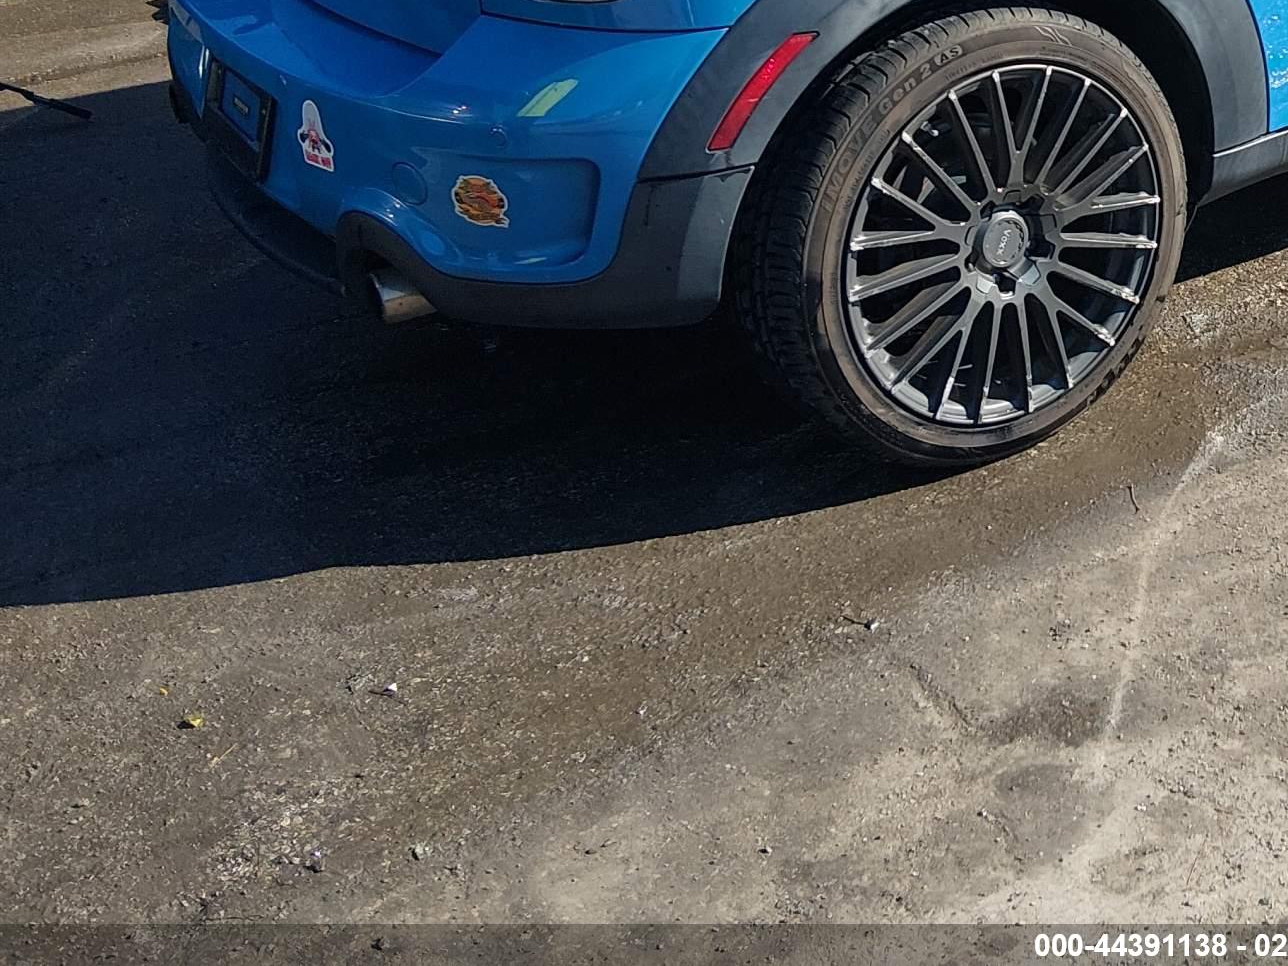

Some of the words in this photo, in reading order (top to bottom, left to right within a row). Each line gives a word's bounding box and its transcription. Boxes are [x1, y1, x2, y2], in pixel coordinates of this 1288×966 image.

[879, 77, 917, 115] Gen
[919, 62, 933, 81] 2
[995, 228, 1012, 257] VOXX
